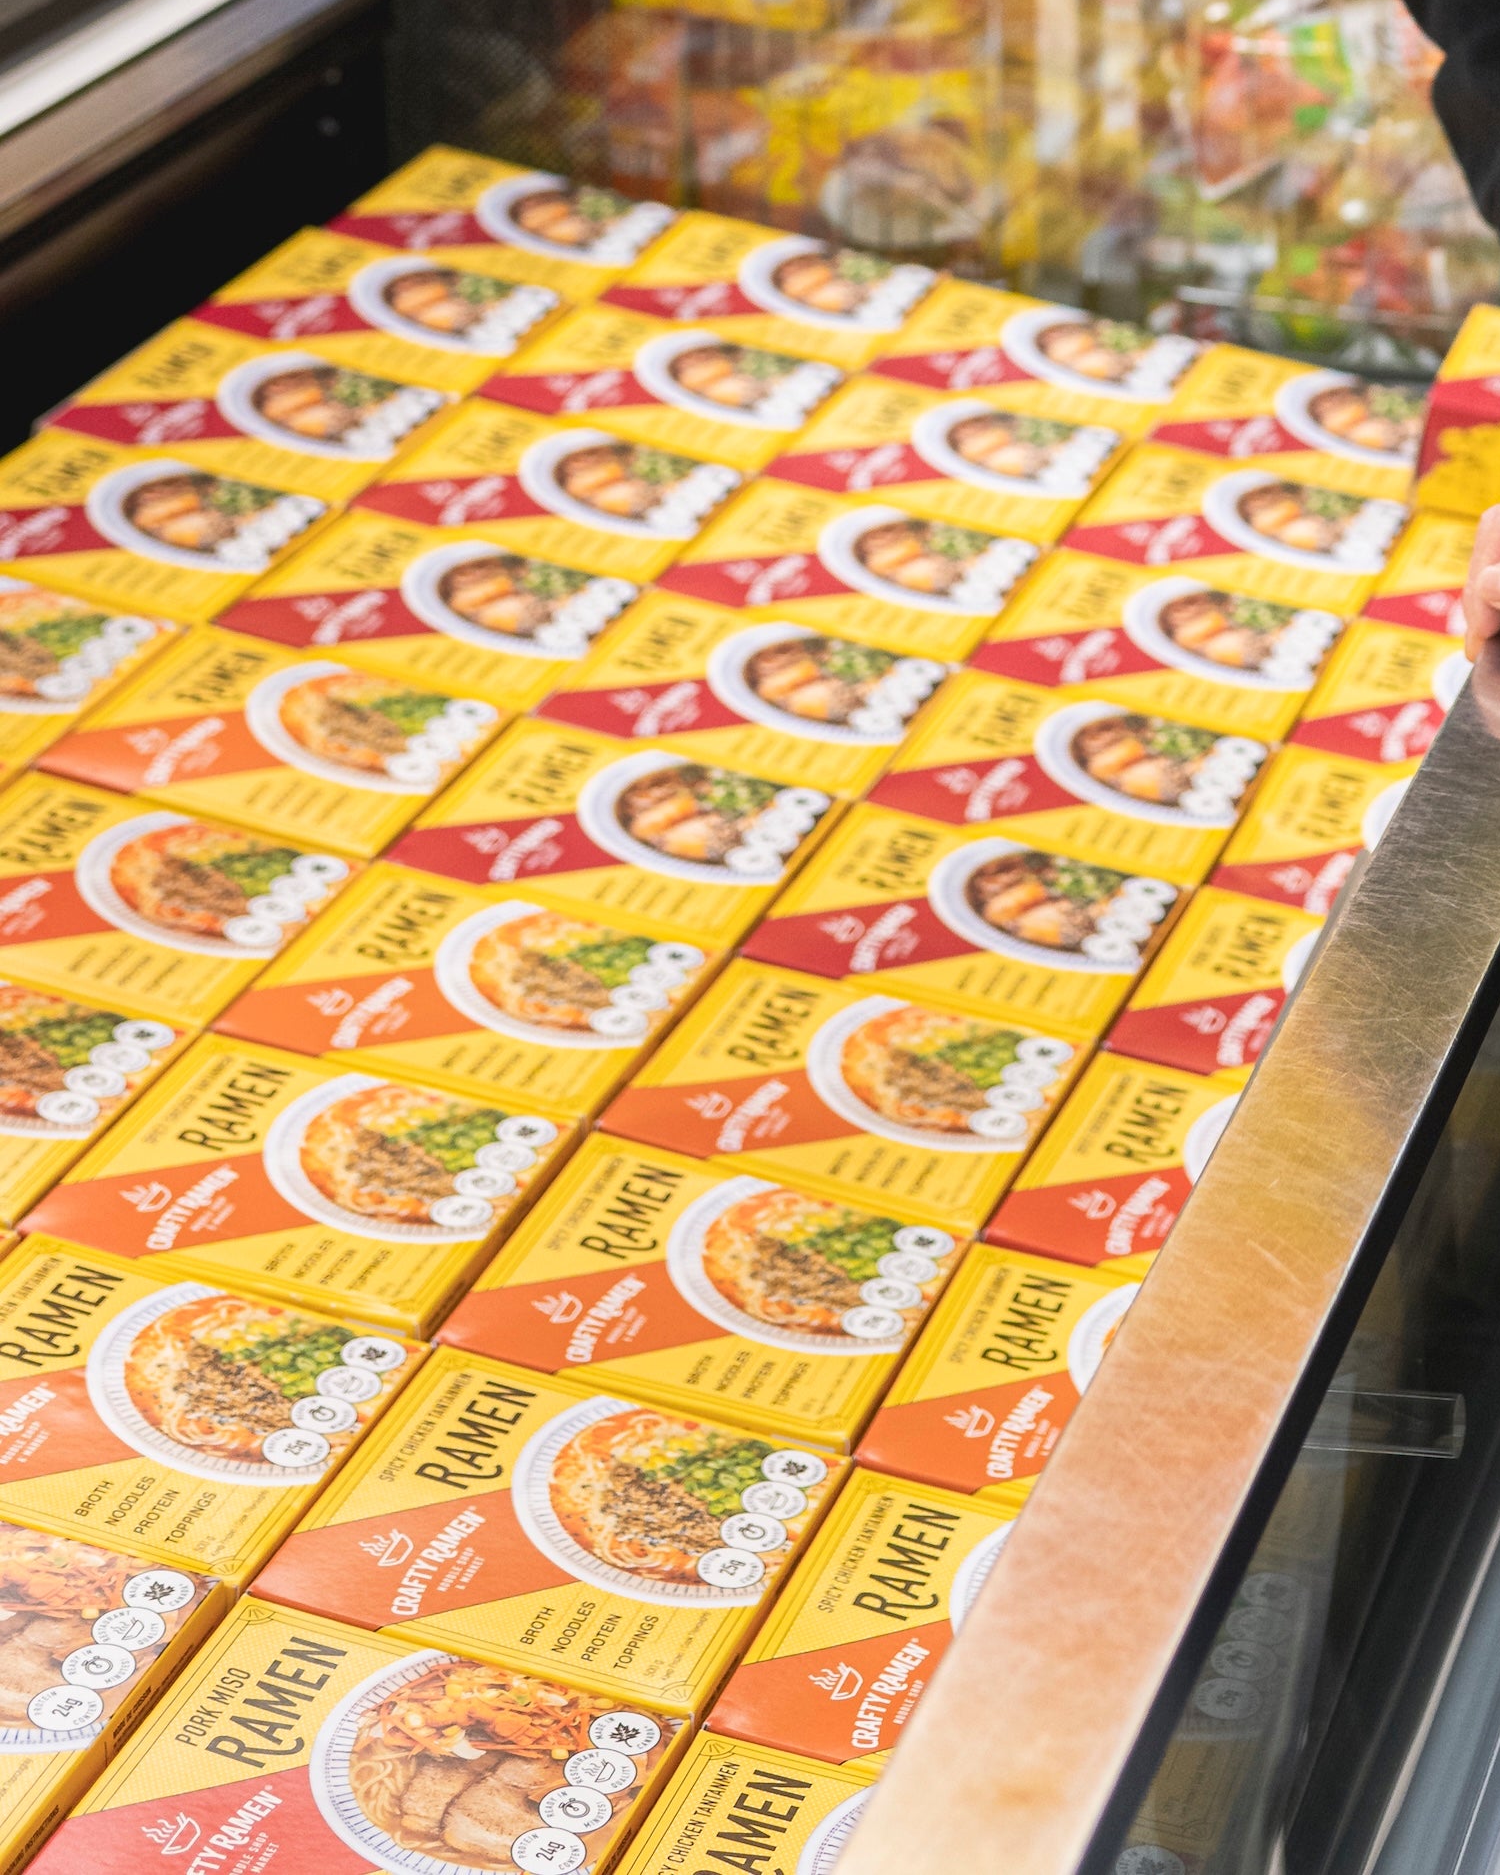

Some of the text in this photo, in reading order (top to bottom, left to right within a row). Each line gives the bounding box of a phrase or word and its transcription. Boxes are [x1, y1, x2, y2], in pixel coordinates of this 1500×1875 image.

[178, 1062, 293, 1152] RAMEN
[580, 1163, 684, 1260] RAMEN
[0, 1265, 125, 1367] RAMEN
[980, 1274, 1072, 1371] RAMEN
[415, 1380, 537, 1490] RAMEN
[75, 1480, 113, 1517] BROTH
[105, 1475, 156, 1527] NOODLES
[133, 1488, 180, 1535] PROTEIN
[164, 1490, 217, 1546] TOPPINGS
[391, 1510, 486, 1615] CRAFTY RAMEN
[719, 1559, 746, 1576] 25g
[818, 1496, 894, 1613] SPICY CHICKEN TANTANMEN
[853, 1504, 961, 1621] RAMEN
[520, 1606, 555, 1646] BROTH
[552, 1600, 596, 1654] NOODLES
[581, 1613, 623, 1662] PROTEIN
[613, 1615, 659, 1670] TOPPINGS
[33, 1691, 58, 1716] PROTEIN
[52, 1697, 83, 1717] 24g
[73, 1700, 97, 1725] CONTENT
[175, 1667, 251, 1747] PORK MISO
[206, 1636, 348, 1768] RAMEN
[851, 1642, 931, 1749] CRAFTY RAMEN
[570, 1751, 600, 1784] RESTAURANT
[611, 1765, 630, 1789] QUALITY
[186, 1790, 283, 1875] FTY RAMEN
[545, 1797, 558, 1818] READY
[667, 1761, 741, 1864] CHICKEN TANTANMEN
[692, 1769, 813, 1875] AMEN
[249, 1832, 269, 1853] SHOP
[251, 1842, 280, 1873] MARKET
[518, 1833, 539, 1859] PROTEIN
[536, 1841, 566, 1861] 24g
[558, 1844, 580, 1871] CONTENT
